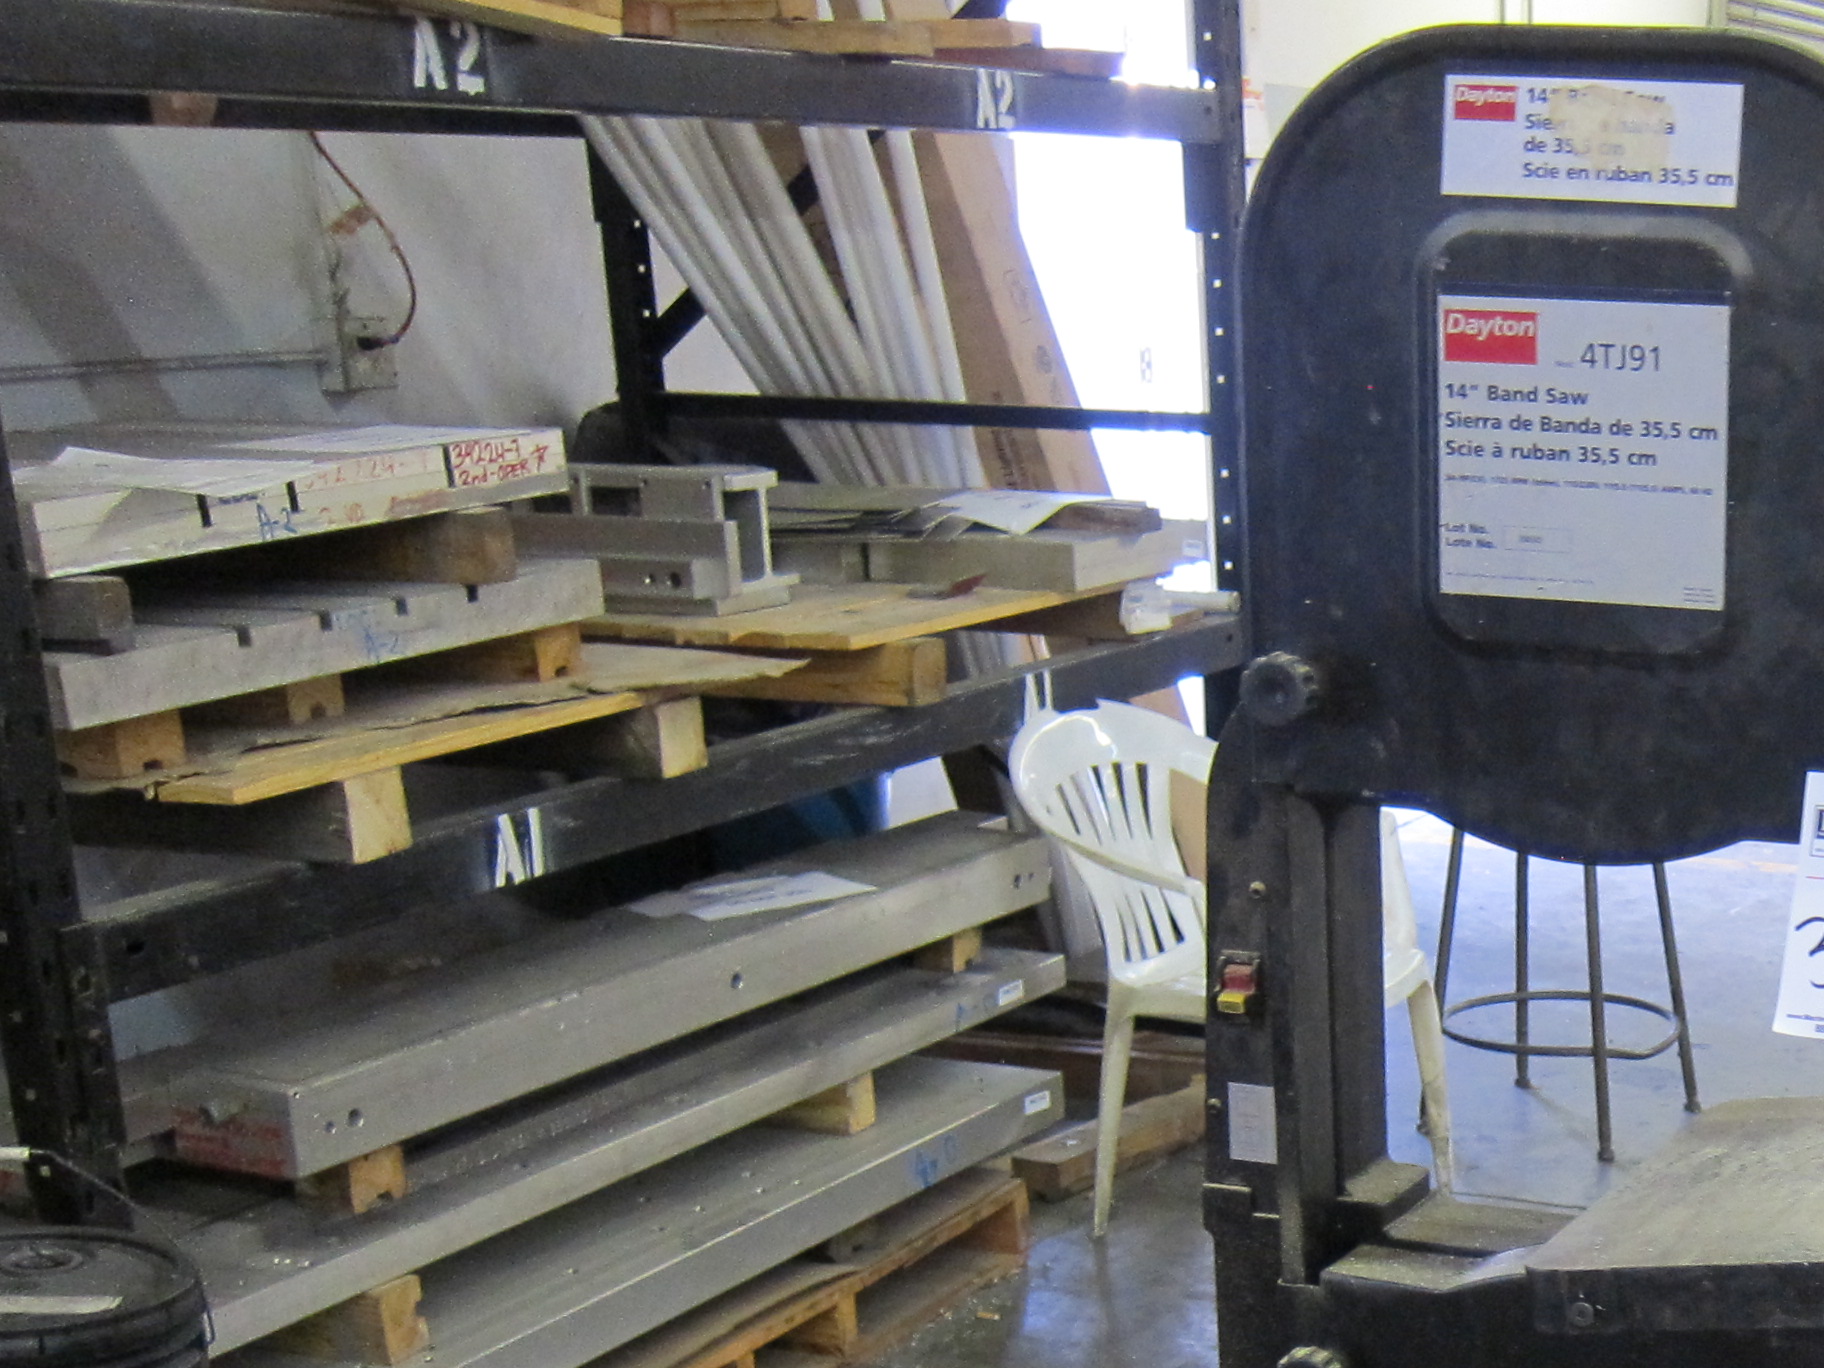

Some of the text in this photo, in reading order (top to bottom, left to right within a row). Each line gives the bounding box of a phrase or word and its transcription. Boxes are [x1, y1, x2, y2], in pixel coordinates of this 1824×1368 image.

[412, 16, 486, 94] A2
[976, 67, 1016, 129] A2
[1523, 138, 1547, 155] de
[1523, 162, 1735, 188] Scie en ruban 35,5 cm
[1446, 313, 1536, 340] Dayton
[1580, 343, 1661, 371] 4TJ91
[1487, 385, 1538, 403] Band
[1546, 388, 1589, 405] Saw
[1444, 411, 1718, 441] Sierra de Banda de 35,5 cm
[1445, 440, 1484, 457] Scie
[1511, 443, 1570, 462] ruban
[1578, 446, 1620, 466] 35,5
[1628, 452, 1657, 466] cm
